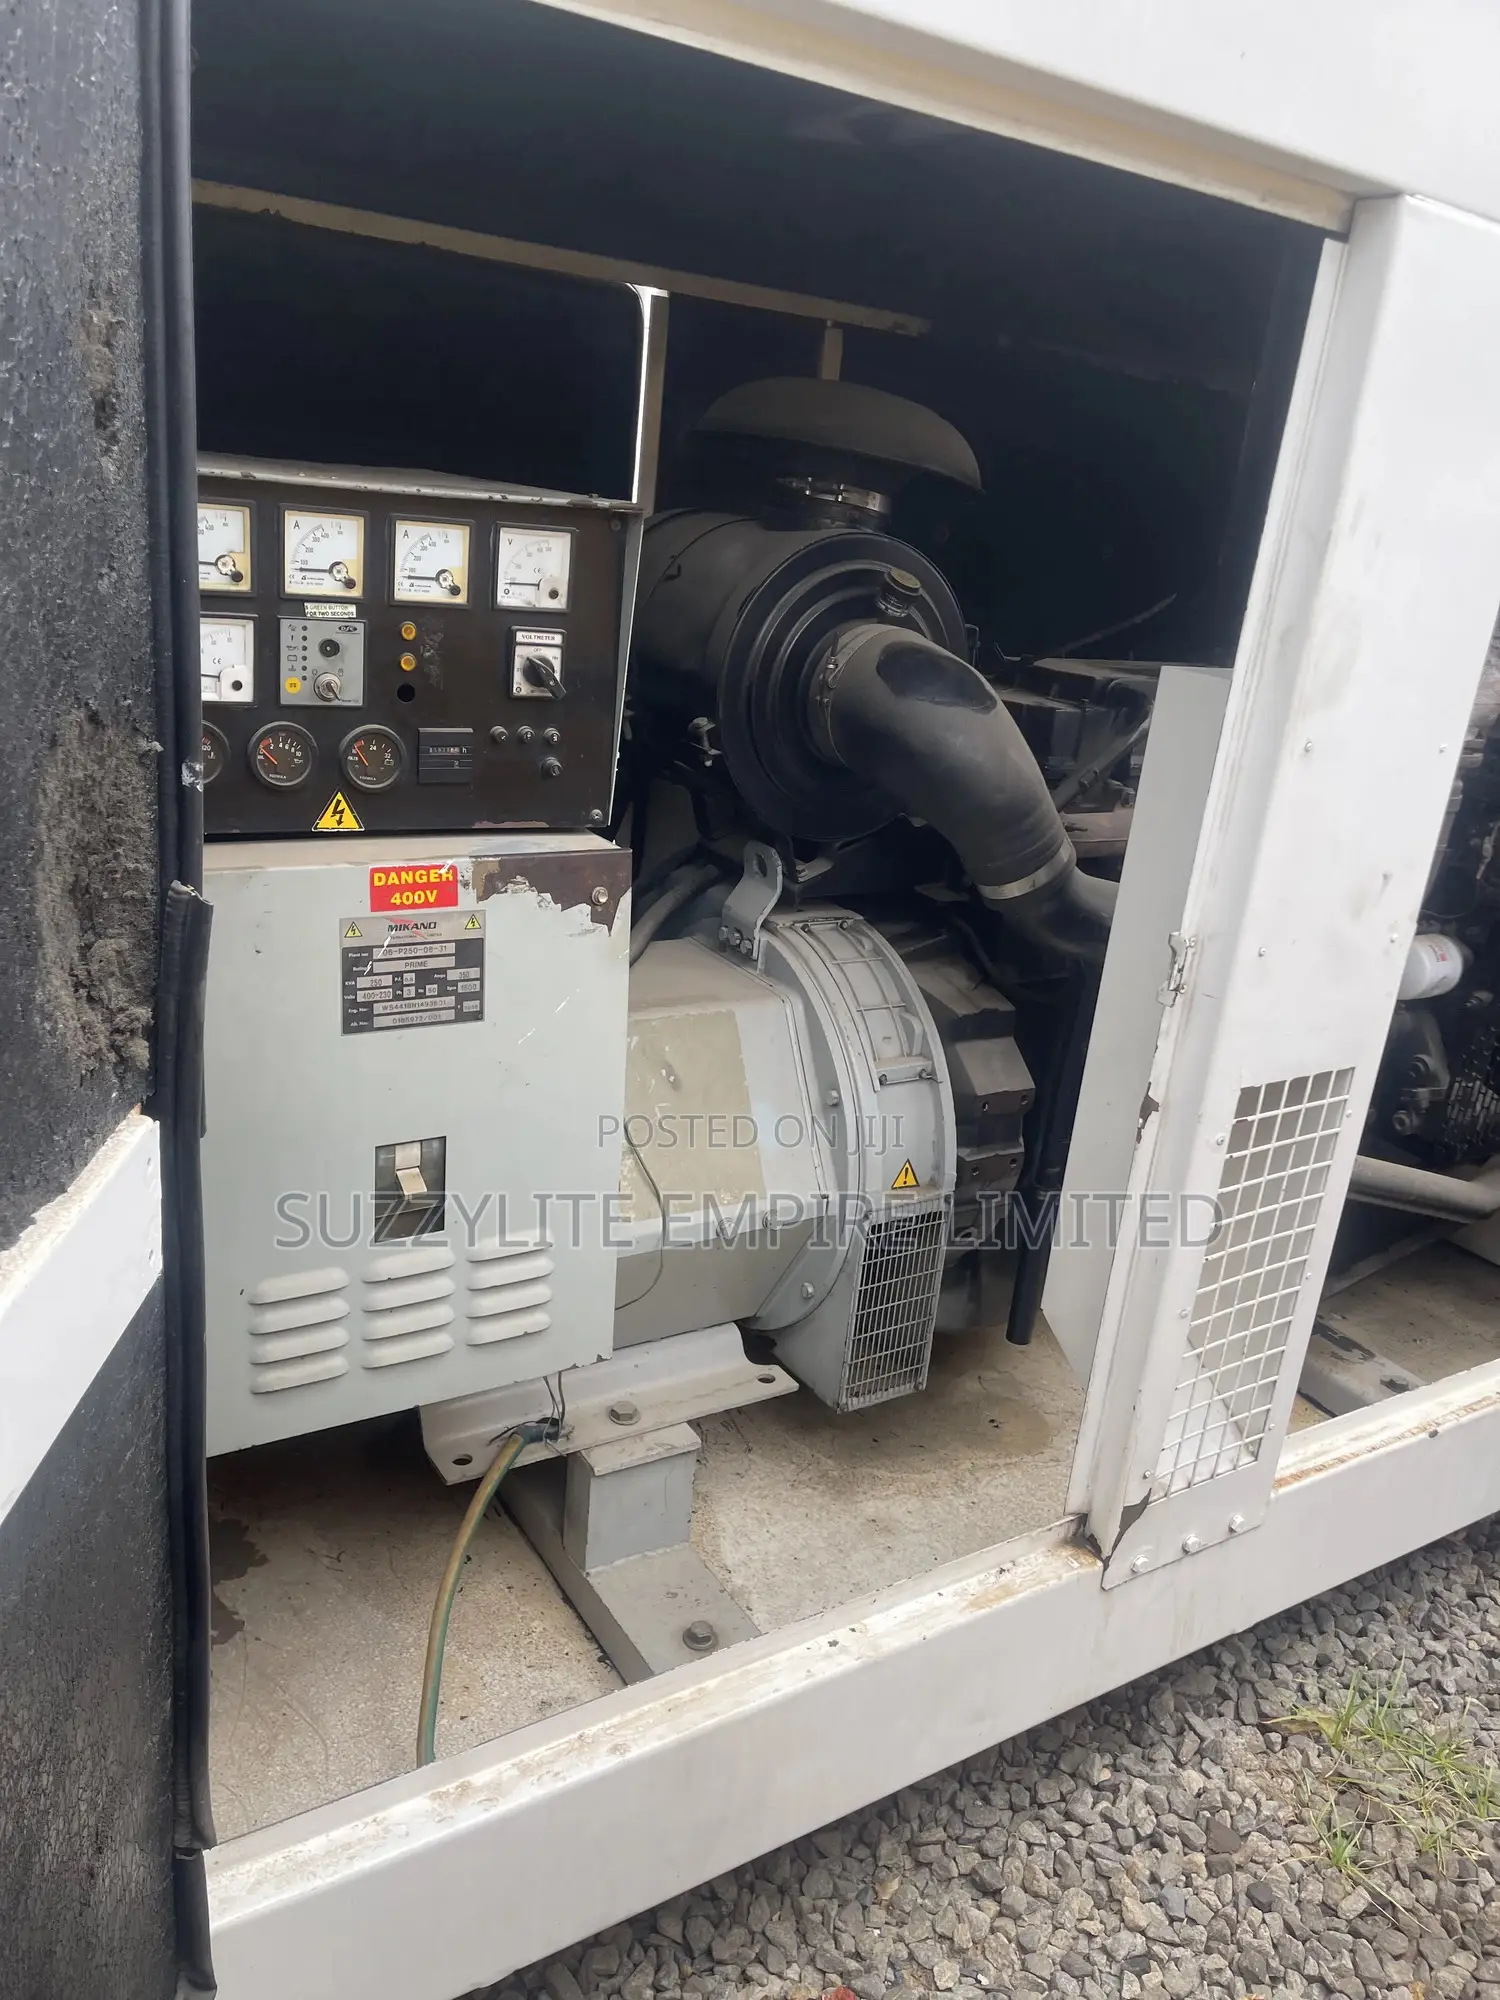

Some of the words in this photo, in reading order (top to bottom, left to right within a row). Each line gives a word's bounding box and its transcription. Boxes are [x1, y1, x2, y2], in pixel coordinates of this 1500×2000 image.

[293, 520, 300, 530] A
[402, 529, 409, 539] A
[507, 538, 513, 546] V
[373, 869, 453, 887] DANGER
[390, 890, 437, 906] 400V
[387, 921, 437, 932] MIKANO
[404, 961, 428, 969] PRIME
[370, 979, 382, 987] 250
[362, 990, 391, 1000] 400-230
[406, 988, 412, 996] 3
